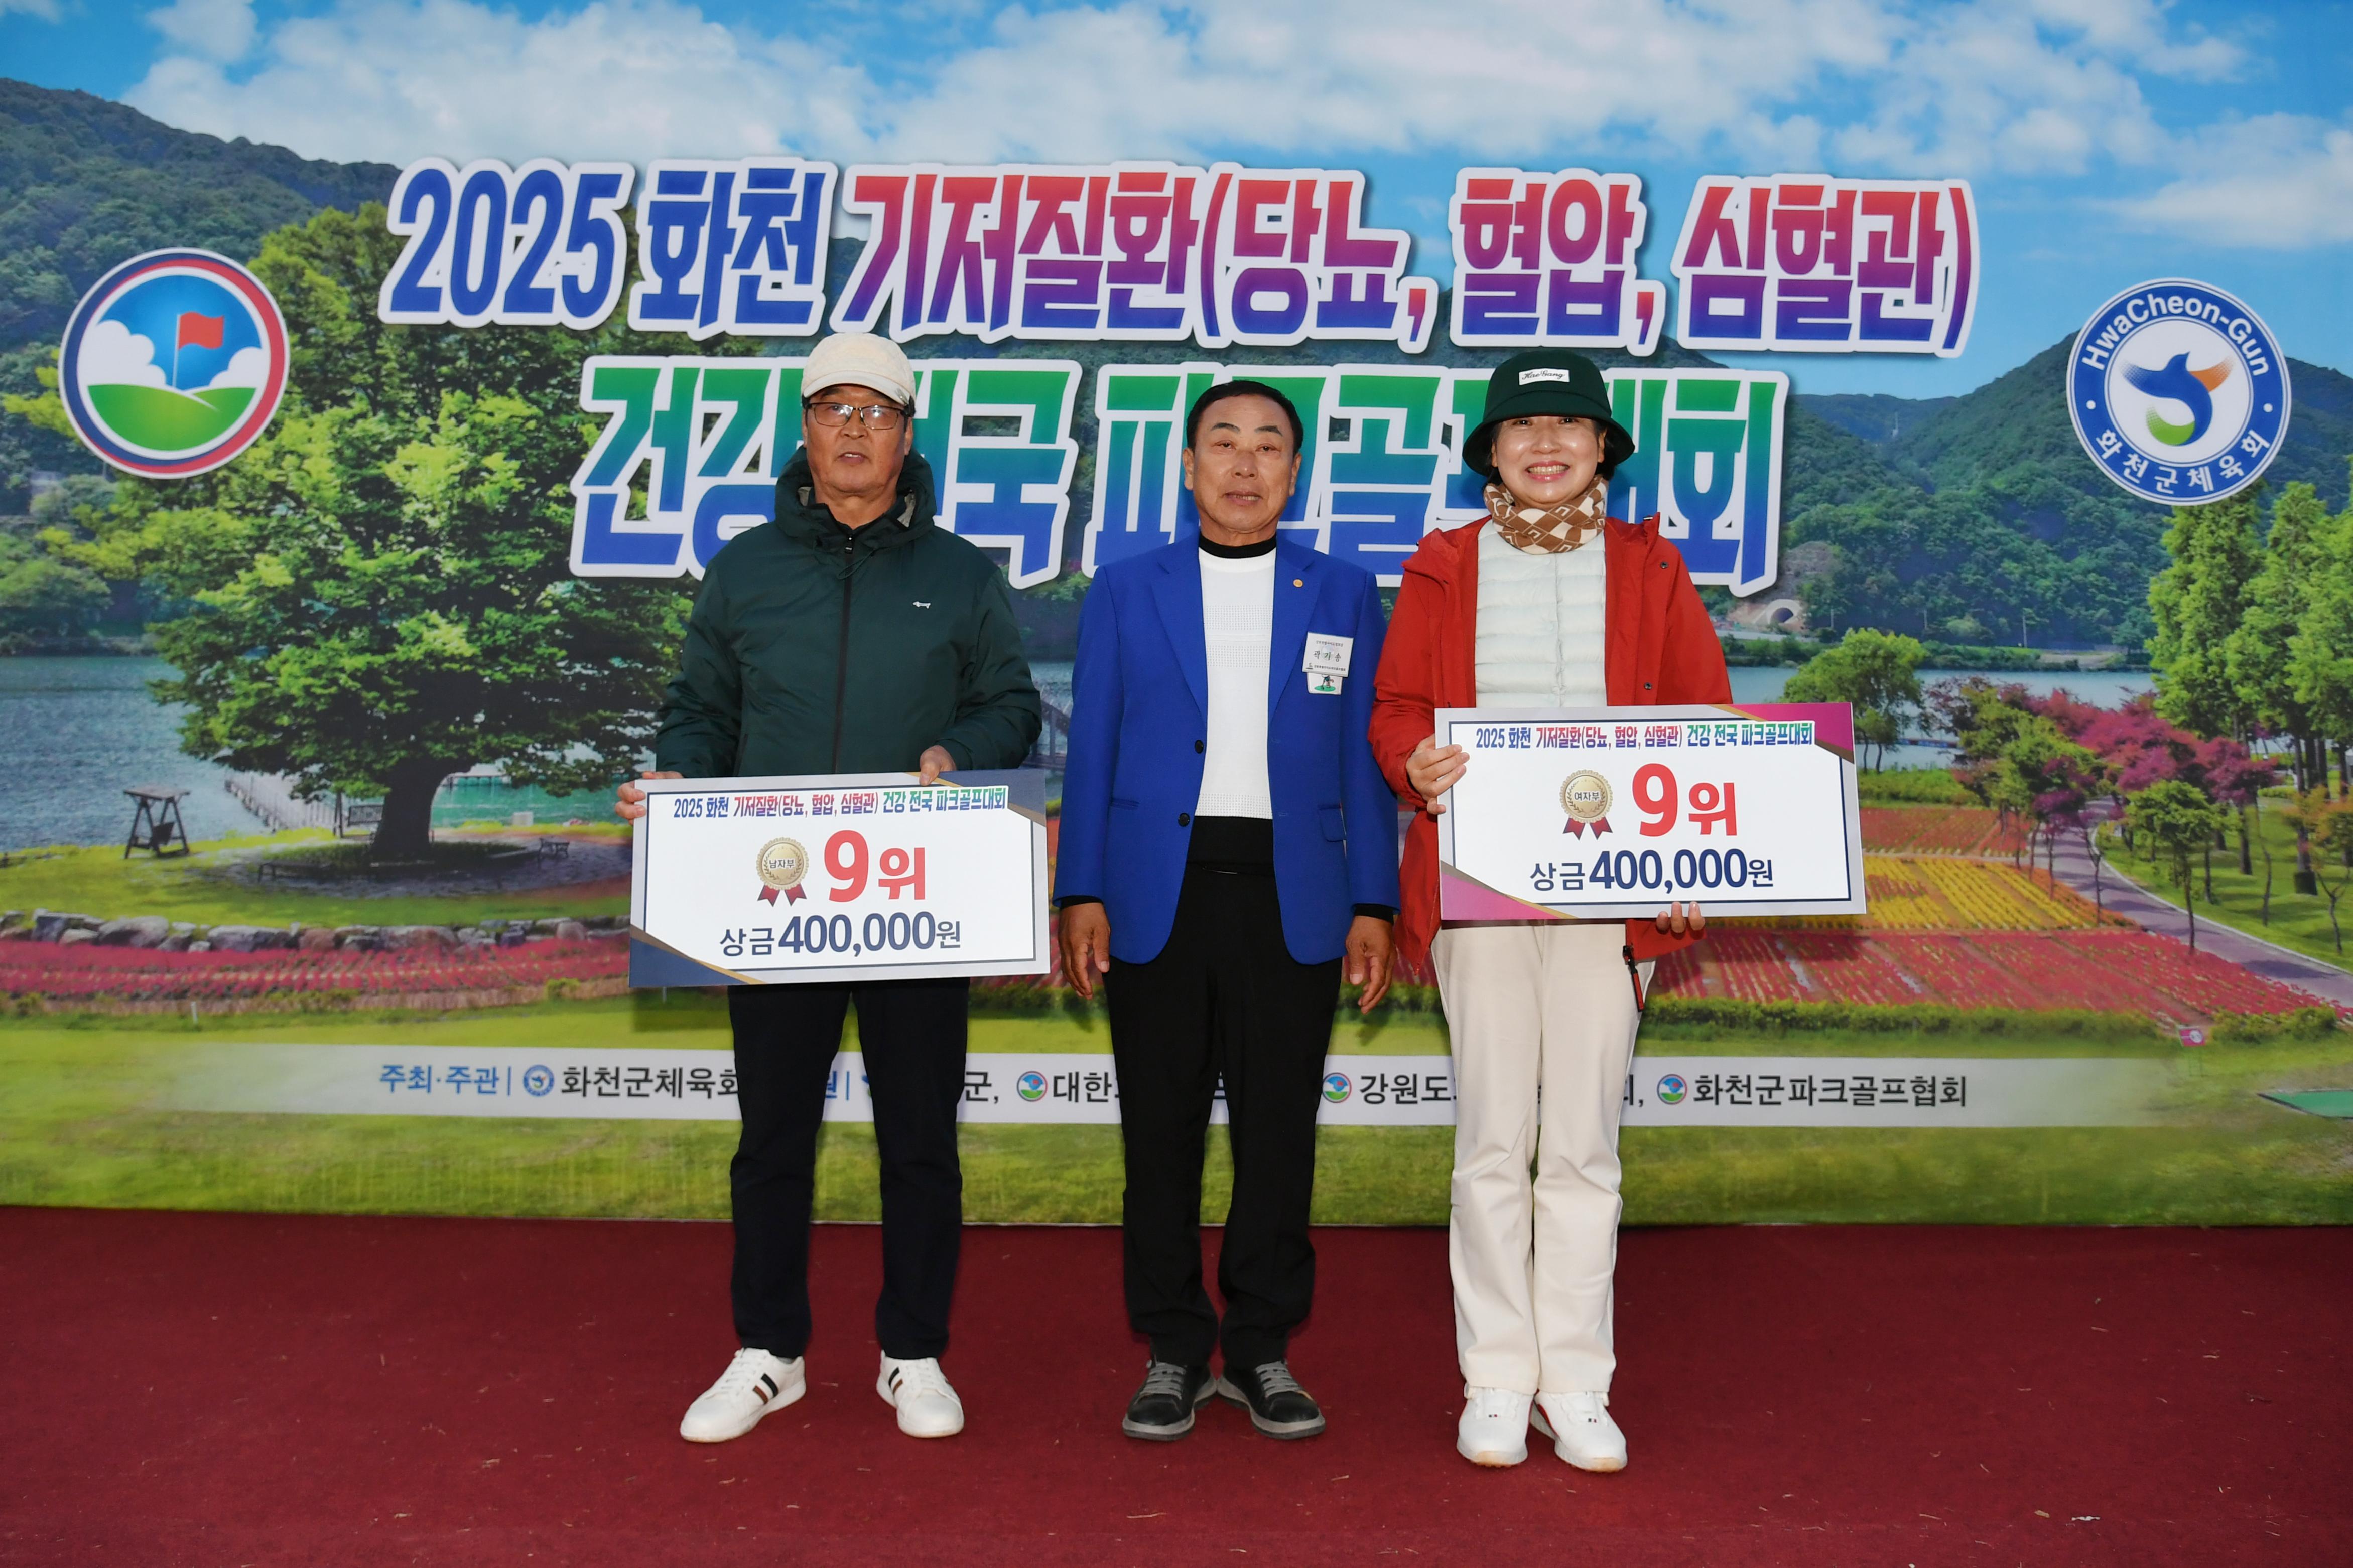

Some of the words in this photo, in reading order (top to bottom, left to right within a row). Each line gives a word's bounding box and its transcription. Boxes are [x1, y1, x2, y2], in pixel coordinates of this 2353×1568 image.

[390, 167, 622, 318] 2025
[639, 166, 827, 329] 화천
[843, 171, 1428, 342] 기저질환(당뇨,
[1459, 176, 1654, 345] 혈압,
[1680, 185, 1973, 350] 심혈관)
[2081, 293, 2269, 376] HwaCheon-Gun
[2096, 429, 2270, 494] 화천군체육회
[1476, 727, 1505, 748] 2025
[1508, 726, 1531, 749] 화천
[1536, 726, 1611, 750] 기저질환(당뇨,
[1615, 726, 1641, 750] 혈압,
[1644, 725, 1682, 748] 심혈관)
[1687, 724, 1711, 747] 건강
[1714, 724, 1738, 746] 전국
[1741, 723, 1813, 746] 파크골프대회
[673, 798, 703, 818] 2025
[705, 797, 729, 818] 화천
[733, 794, 808, 818] 기저질환(당뇨,
[811, 794, 837, 817] 혈압,
[841, 792, 878, 814] 심혈관)
[883, 791, 906, 813] 건강
[909, 790, 933, 812] 전국
[936, 787, 1007, 811] 파크골프대회
[1574, 791, 1600, 801] 여자부
[769, 859, 795, 869] 남자부
[1053, 1071, 1120, 1102] 대한
[1360, 1072, 1456, 1104] 강원도
